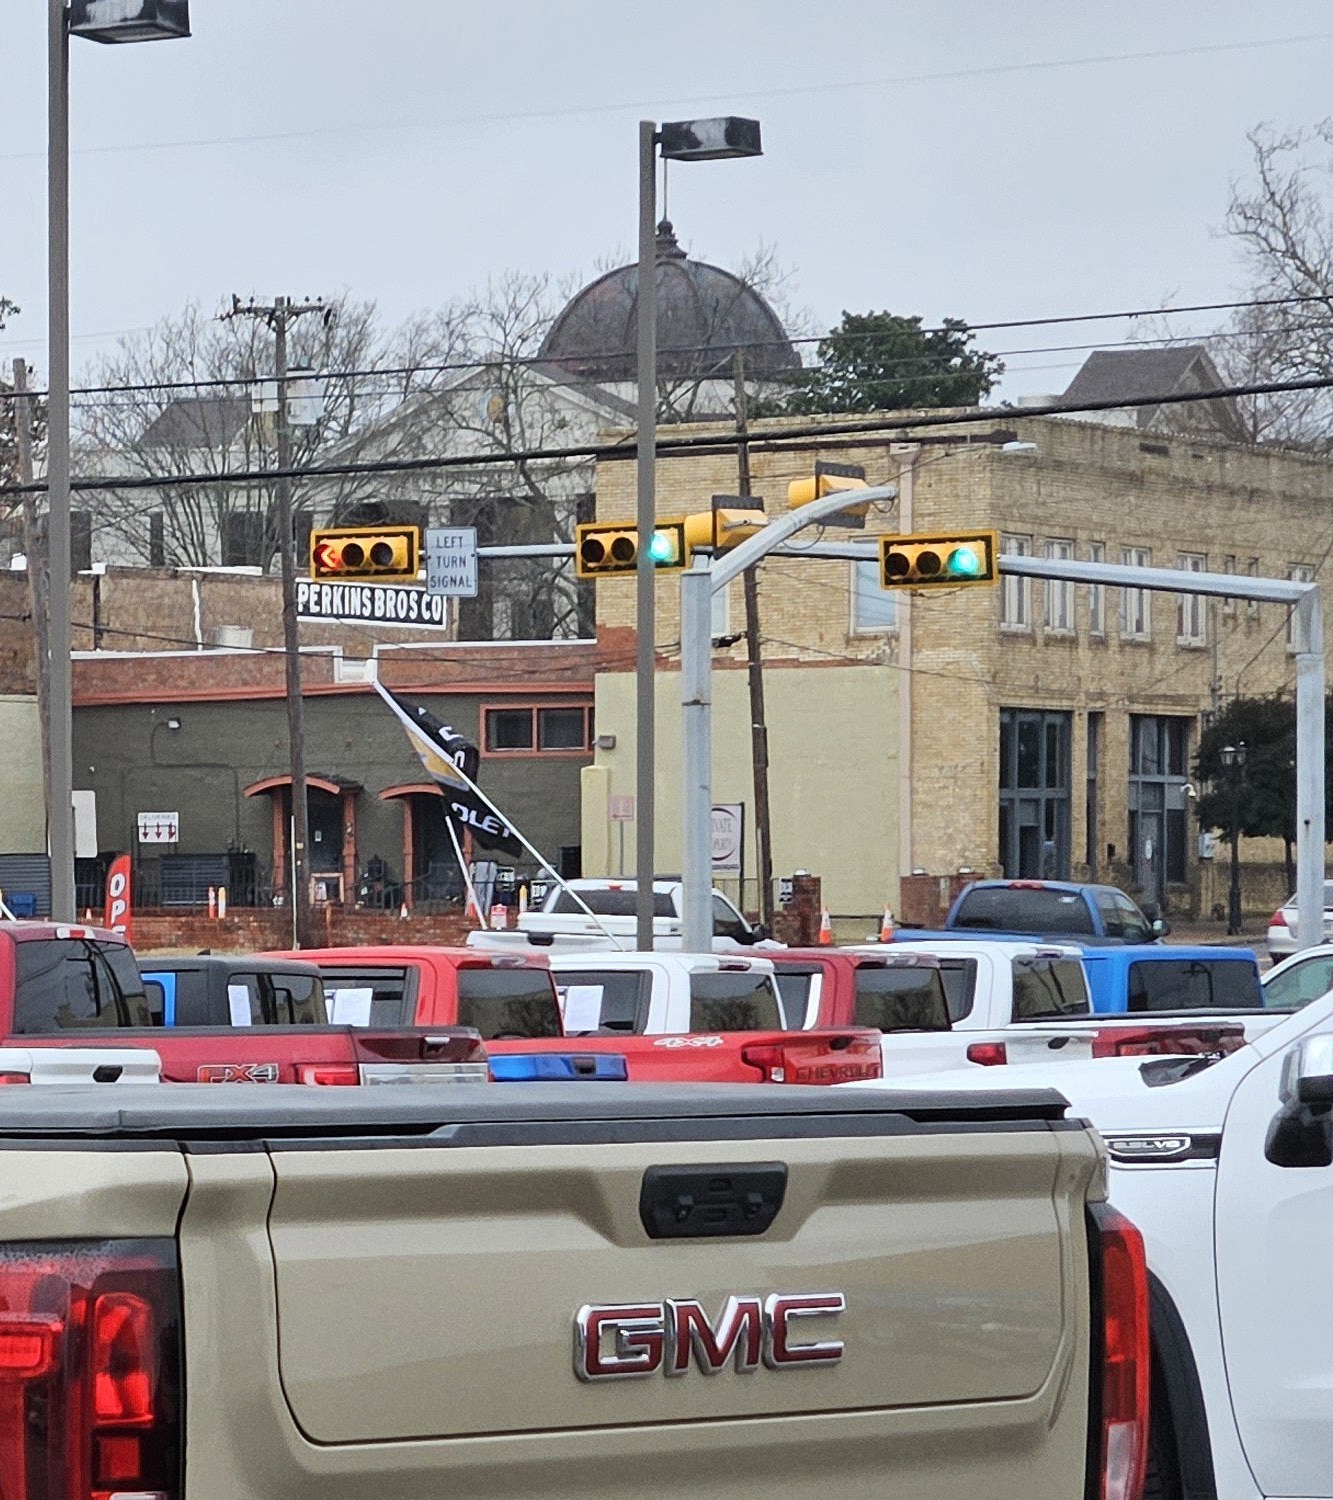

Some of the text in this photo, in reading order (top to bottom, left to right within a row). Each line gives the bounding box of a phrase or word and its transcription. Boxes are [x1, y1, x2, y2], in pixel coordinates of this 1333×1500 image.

[436, 536, 464, 549] LEFT
[436, 556, 466, 568] TURN
[430, 575, 472, 588] SIGNAL
[297, 583, 442, 622] PERKINS BROS CO
[197, 1063, 279, 1083] FX4
[573, 1292, 846, 1382] GMC
